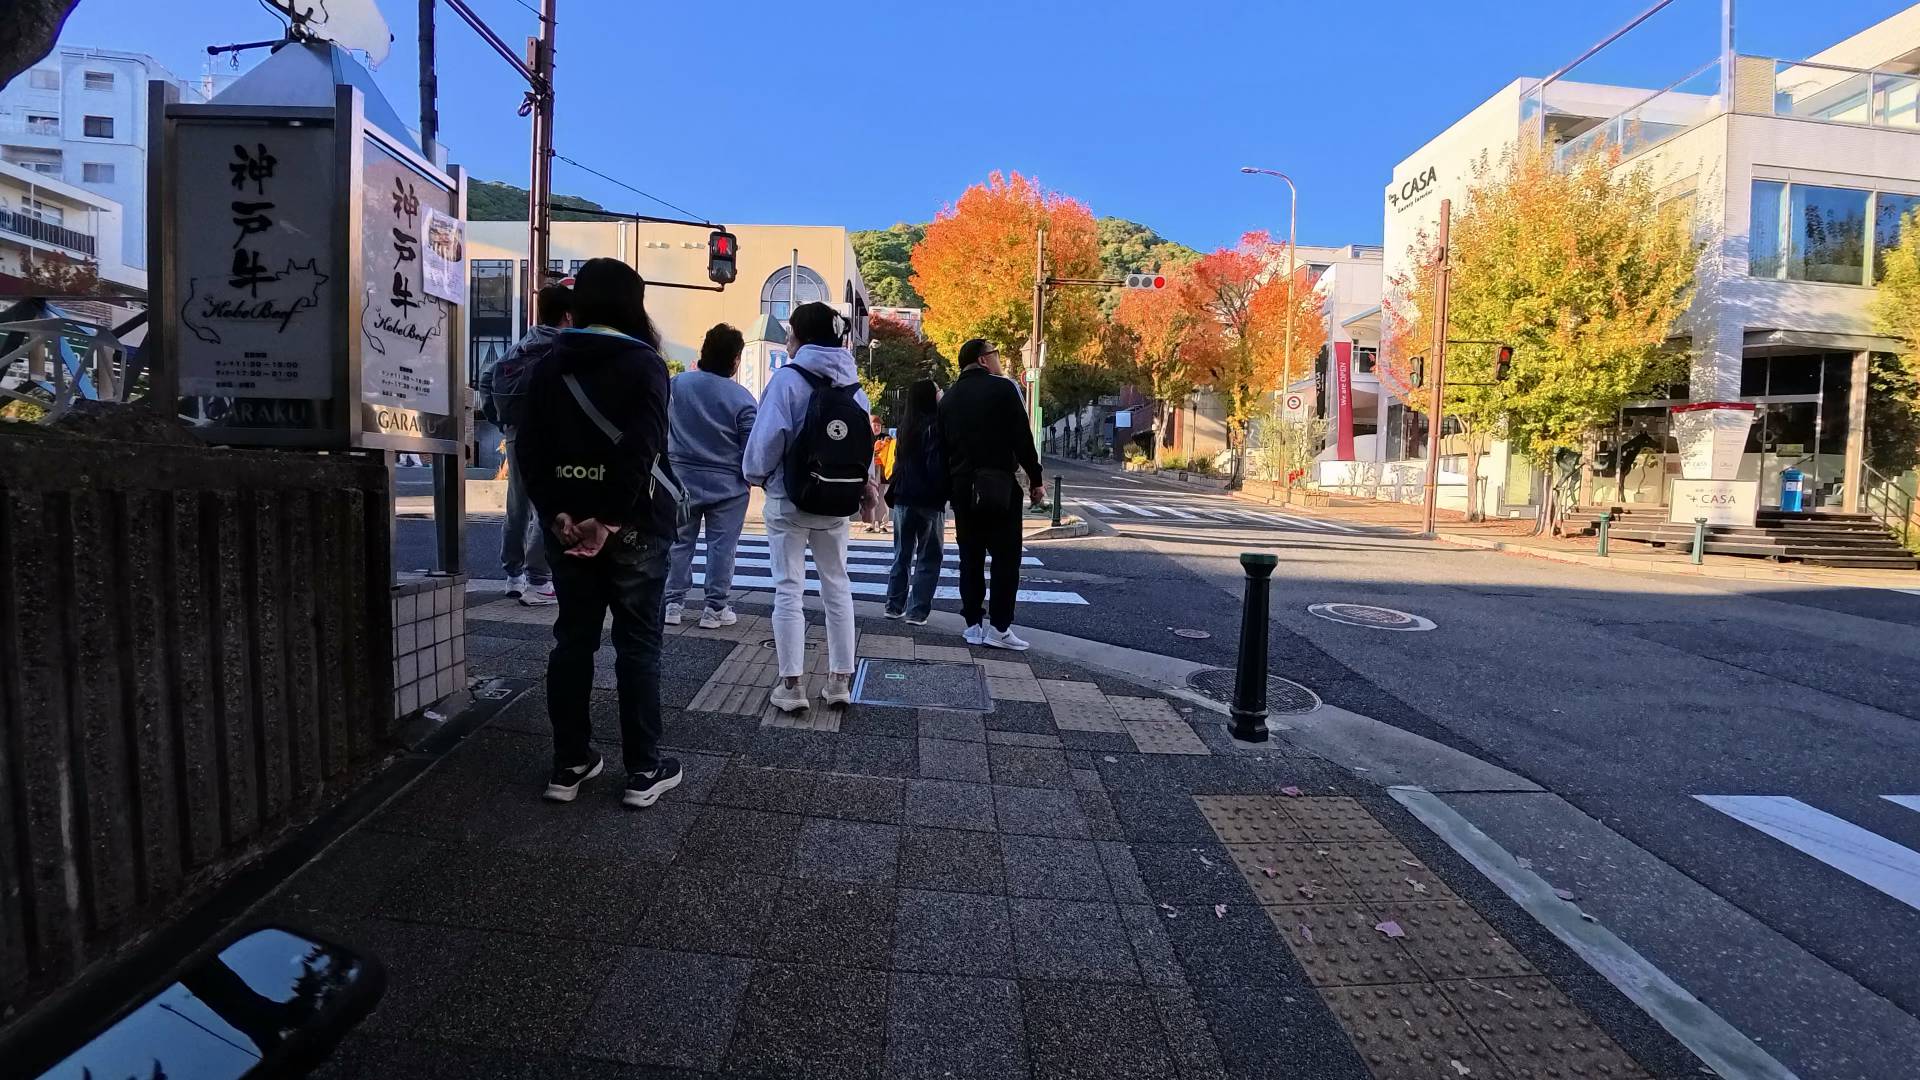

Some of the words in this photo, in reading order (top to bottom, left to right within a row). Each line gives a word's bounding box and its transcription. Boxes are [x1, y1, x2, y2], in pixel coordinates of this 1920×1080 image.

[1402, 166, 1437, 200] CASA
[228, 143, 278, 298] 神戸牛
[390, 176, 421, 319] 神戸牛
[202, 298, 249, 319] Kobe
[249, 297, 308, 333] Beef
[374, 316, 404, 336] Kobe
[1701, 494, 1736, 504] CASA
